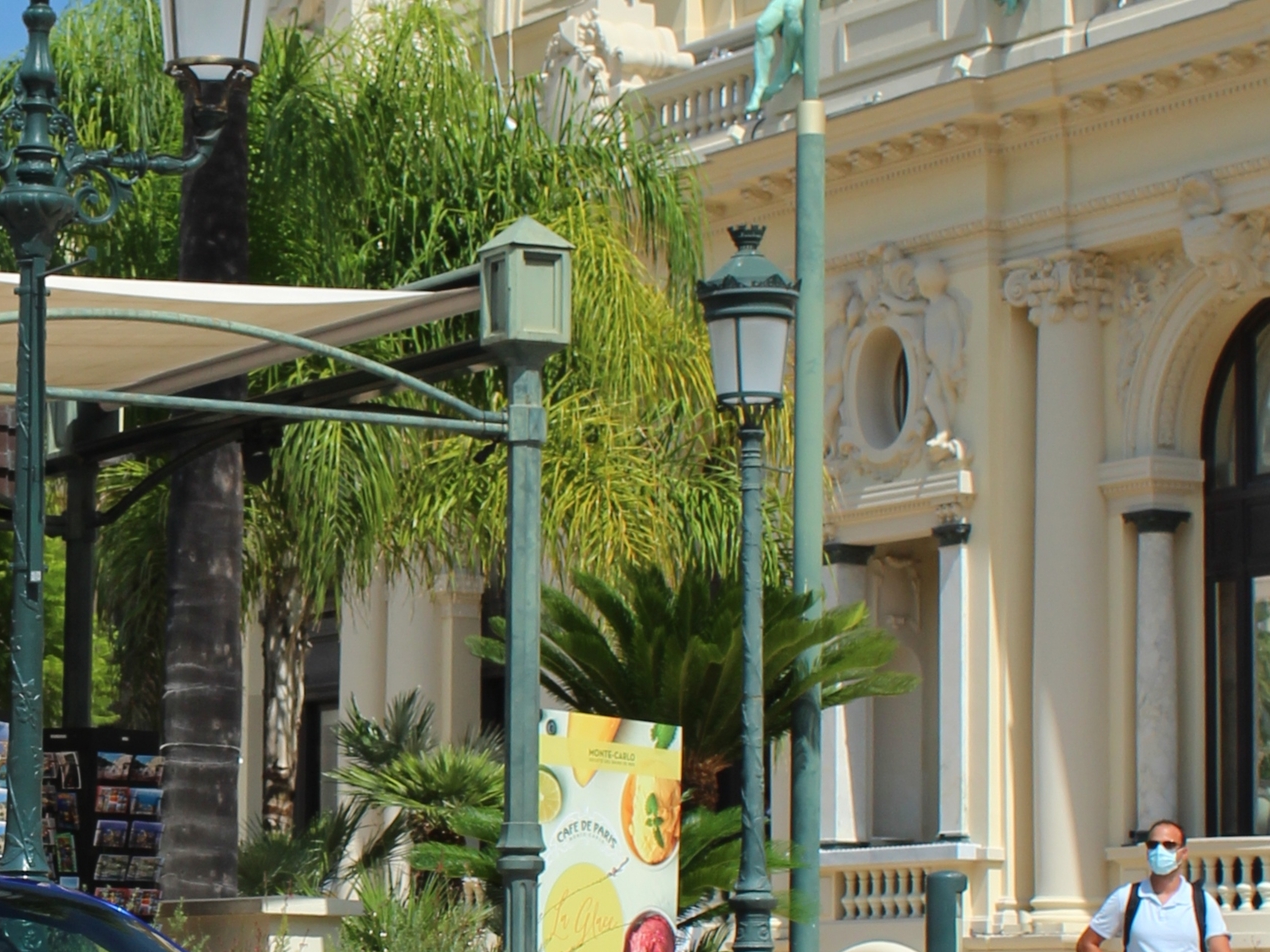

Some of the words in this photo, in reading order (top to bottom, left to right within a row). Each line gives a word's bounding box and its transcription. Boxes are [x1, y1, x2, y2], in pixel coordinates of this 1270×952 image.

[589, 748, 636, 762] MONTE-CARLO
[581, 820, 592, 831] DE
[593, 822, 618, 849] PARIS
